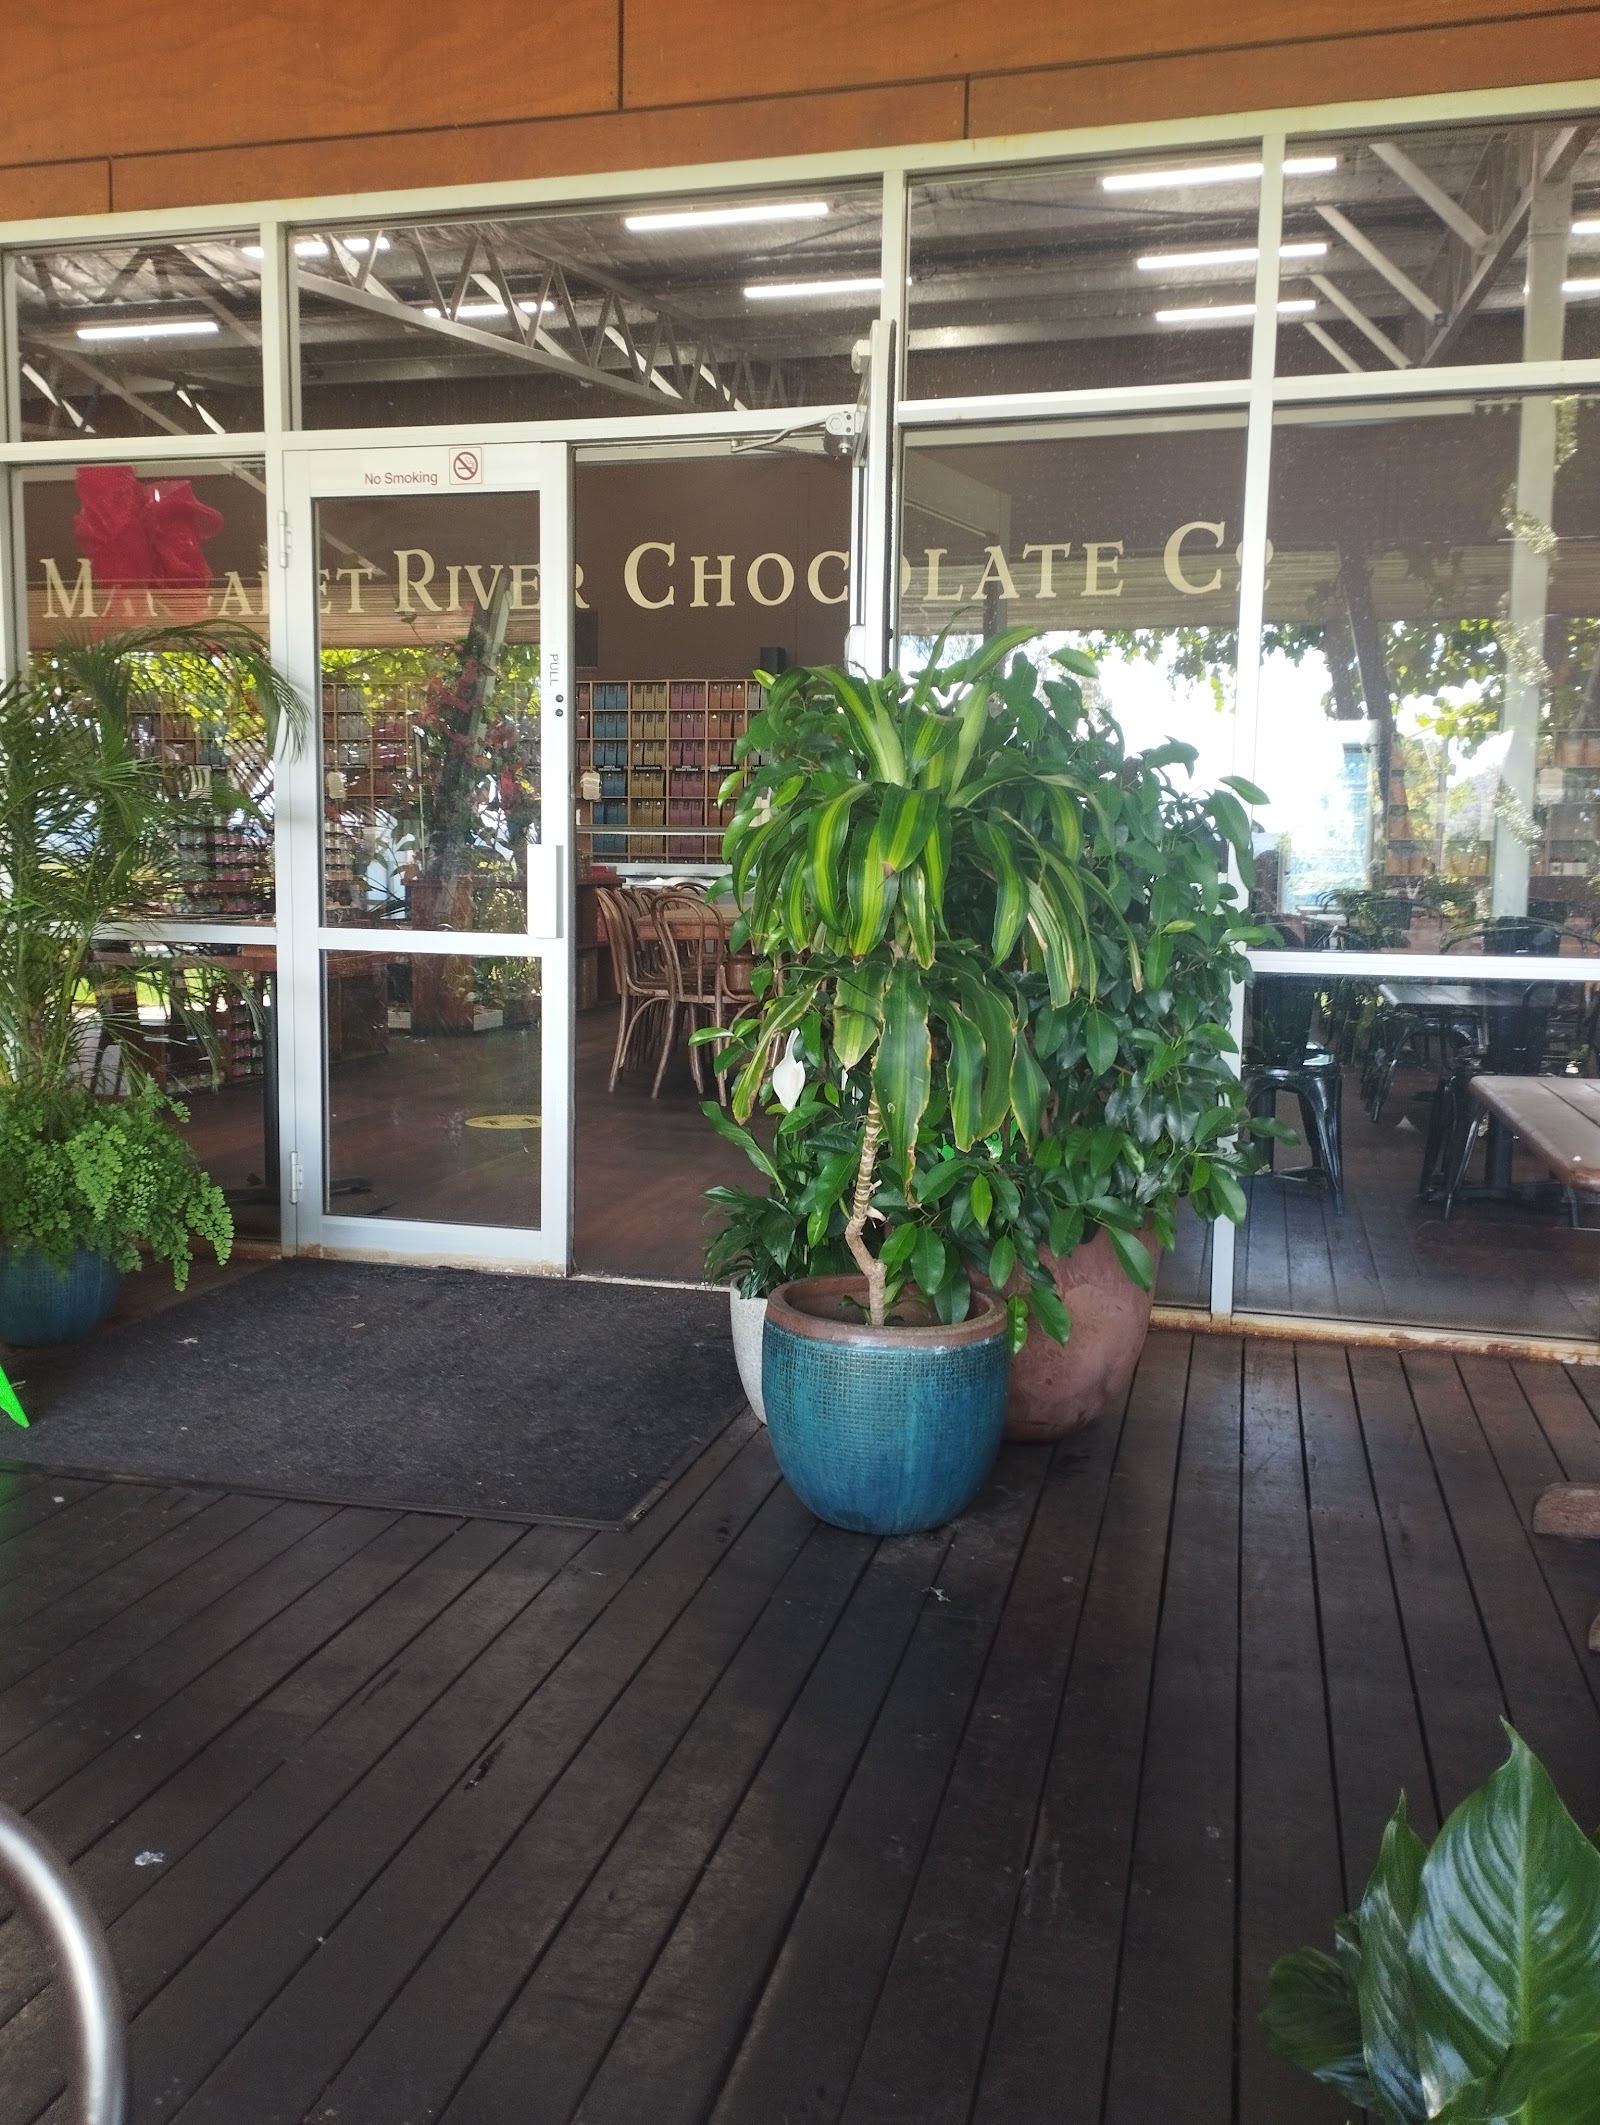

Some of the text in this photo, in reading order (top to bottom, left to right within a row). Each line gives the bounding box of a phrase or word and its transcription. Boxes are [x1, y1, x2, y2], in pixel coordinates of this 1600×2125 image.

[364, 471, 438, 486] No Smoking
[624, 540, 1124, 610] CHOCLATE
[549, 653, 559, 687] PULL
